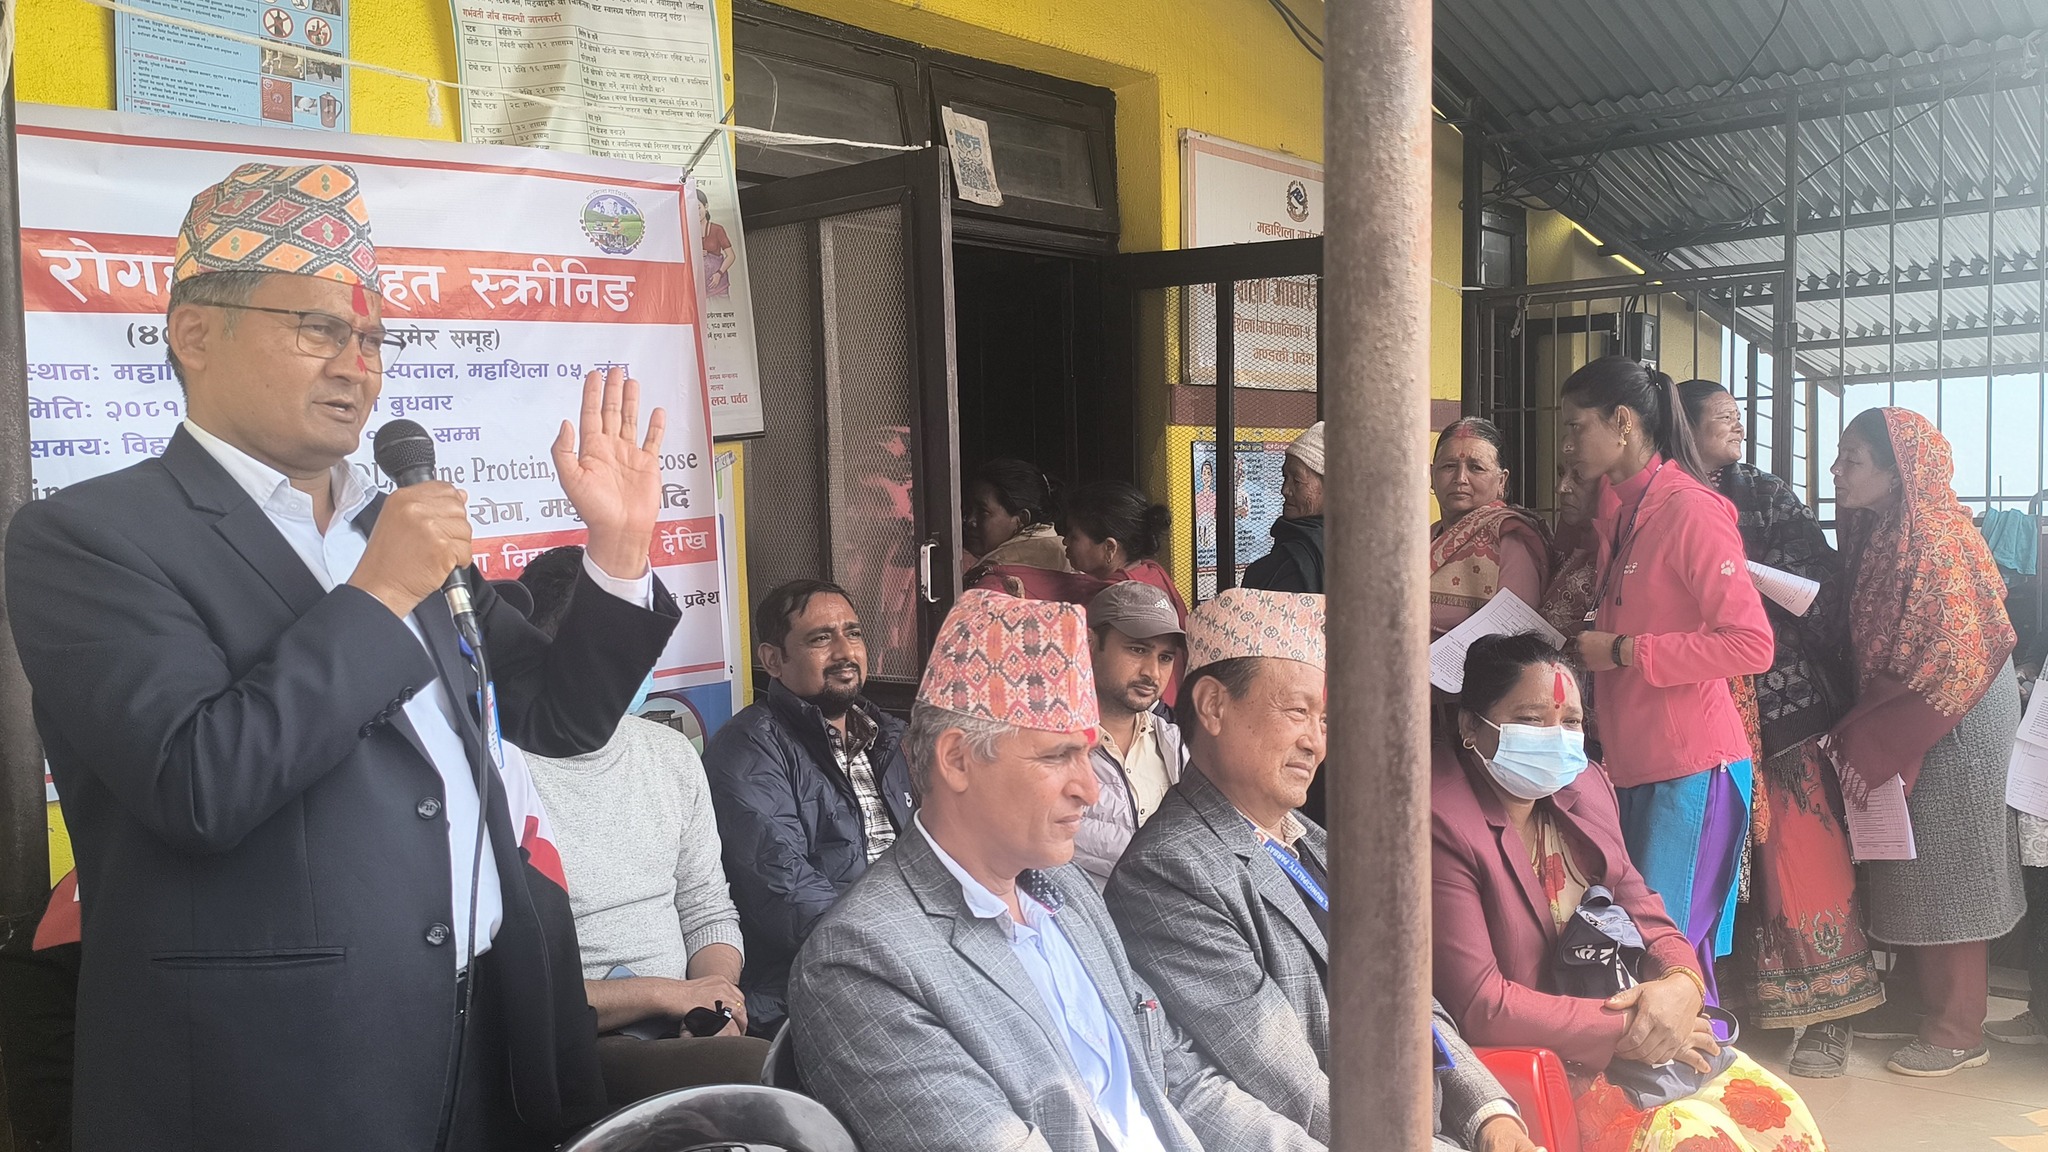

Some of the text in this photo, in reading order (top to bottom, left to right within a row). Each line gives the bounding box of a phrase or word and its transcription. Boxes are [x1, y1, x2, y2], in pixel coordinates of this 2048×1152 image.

[462, 7, 484, 19] गर्भवती
[486, 8, 500, 21] जाँच
[527, 12, 562, 24] जानकारी
[38, 238, 175, 303] रोग
[378, 264, 446, 312] हत
[449, 328, 500, 352] समूह)
[385, 363, 459, 380] स्पताल,
[467, 358, 550, 380] महाशिला
[388, 395, 454, 418] बुधवार
[730, 392, 748, 405] पर्वत
[433, 427, 482, 443] सम्म
[472, 456, 557, 486] Protein,
[469, 497, 530, 525] रोग,
[660, 526, 709, 555] देखि
[684, 589, 720, 609] प्रदेश
